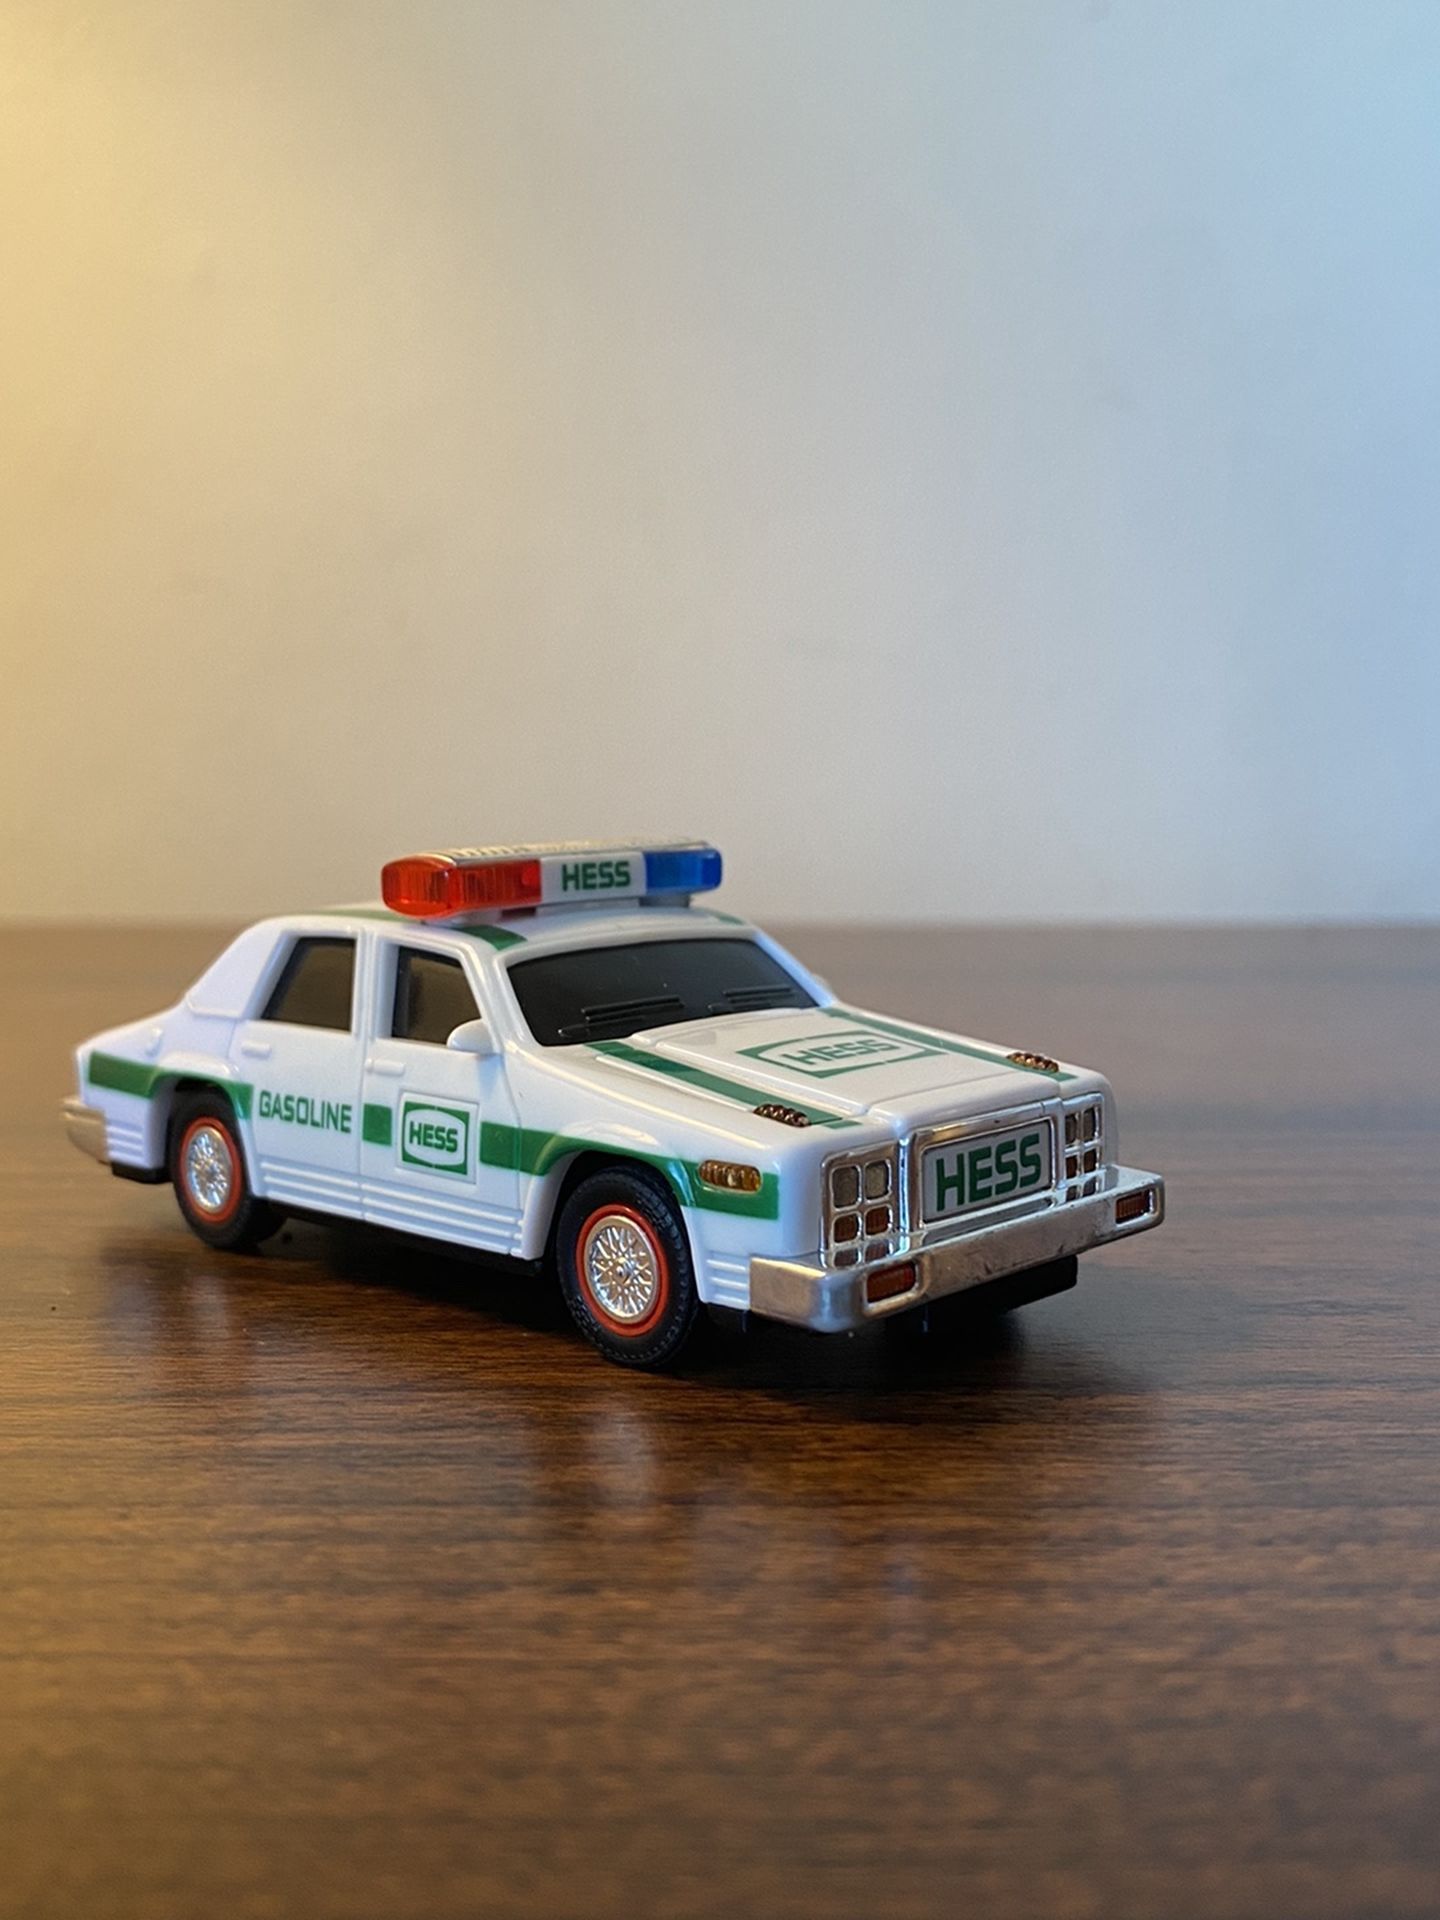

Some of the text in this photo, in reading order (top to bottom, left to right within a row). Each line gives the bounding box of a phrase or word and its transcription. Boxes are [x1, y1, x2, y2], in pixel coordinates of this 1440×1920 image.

[562, 861, 631, 891] HESS
[780, 1039, 899, 1066] HESS
[259, 1091, 352, 1133] GASOLINE
[409, 1121, 458, 1152] HESS
[935, 1134, 1042, 1212] HESS
